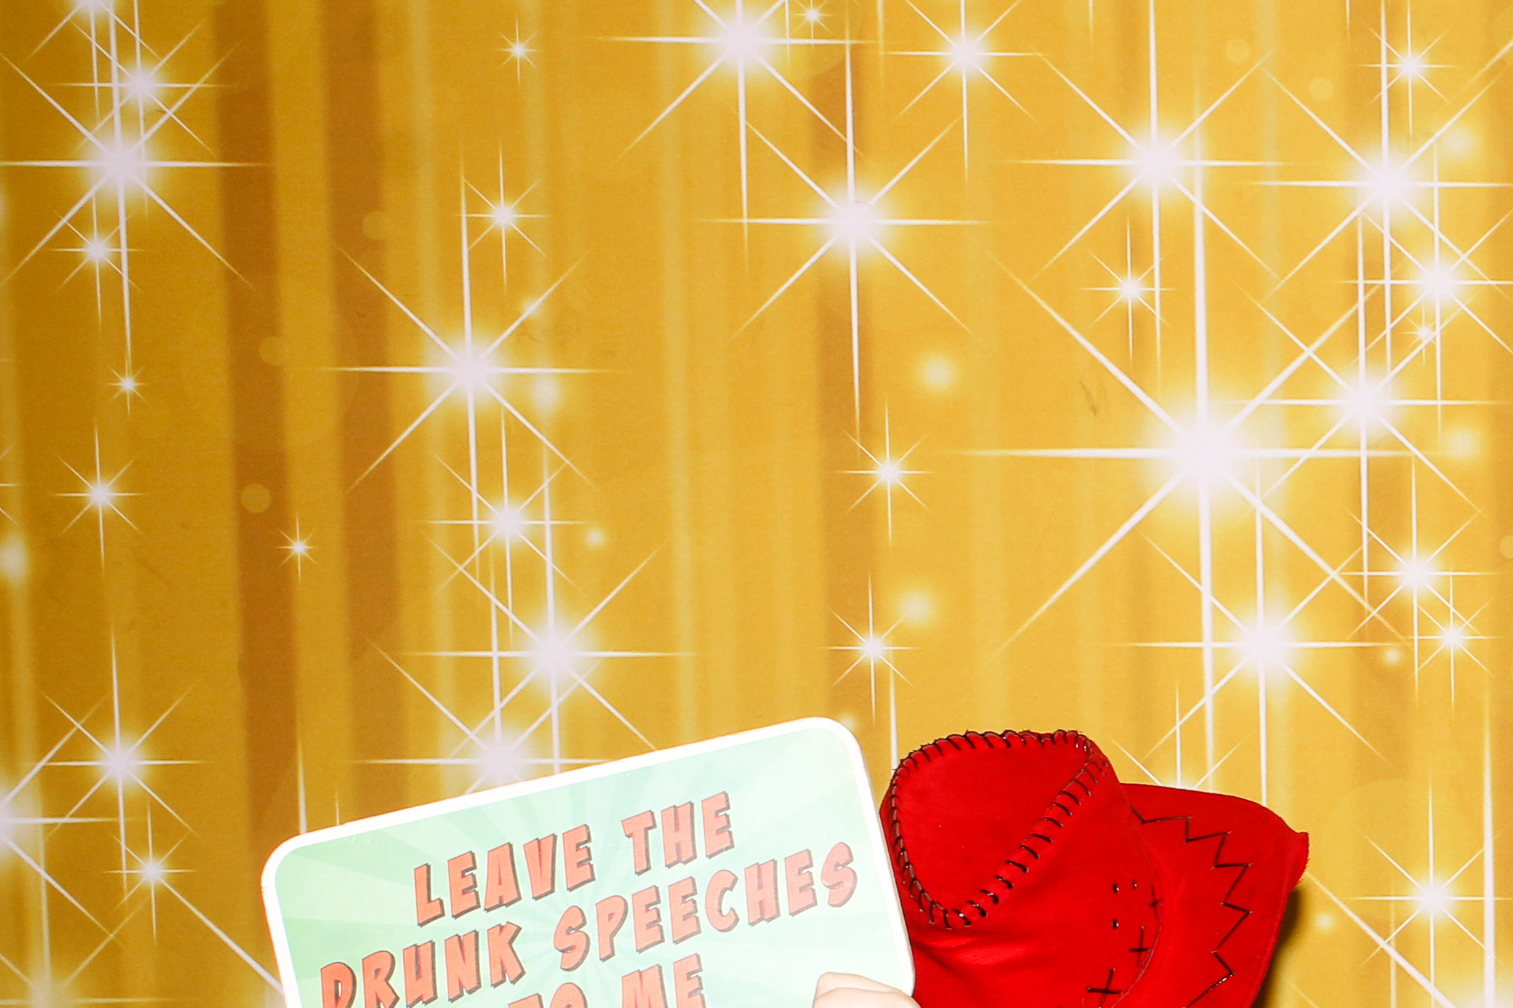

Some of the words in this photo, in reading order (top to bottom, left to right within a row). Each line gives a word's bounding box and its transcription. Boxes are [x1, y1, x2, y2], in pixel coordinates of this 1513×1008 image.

[413, 824, 596, 926] LEAVE
[620, 791, 735, 876] THE
[552, 841, 858, 972] SPEECHES
